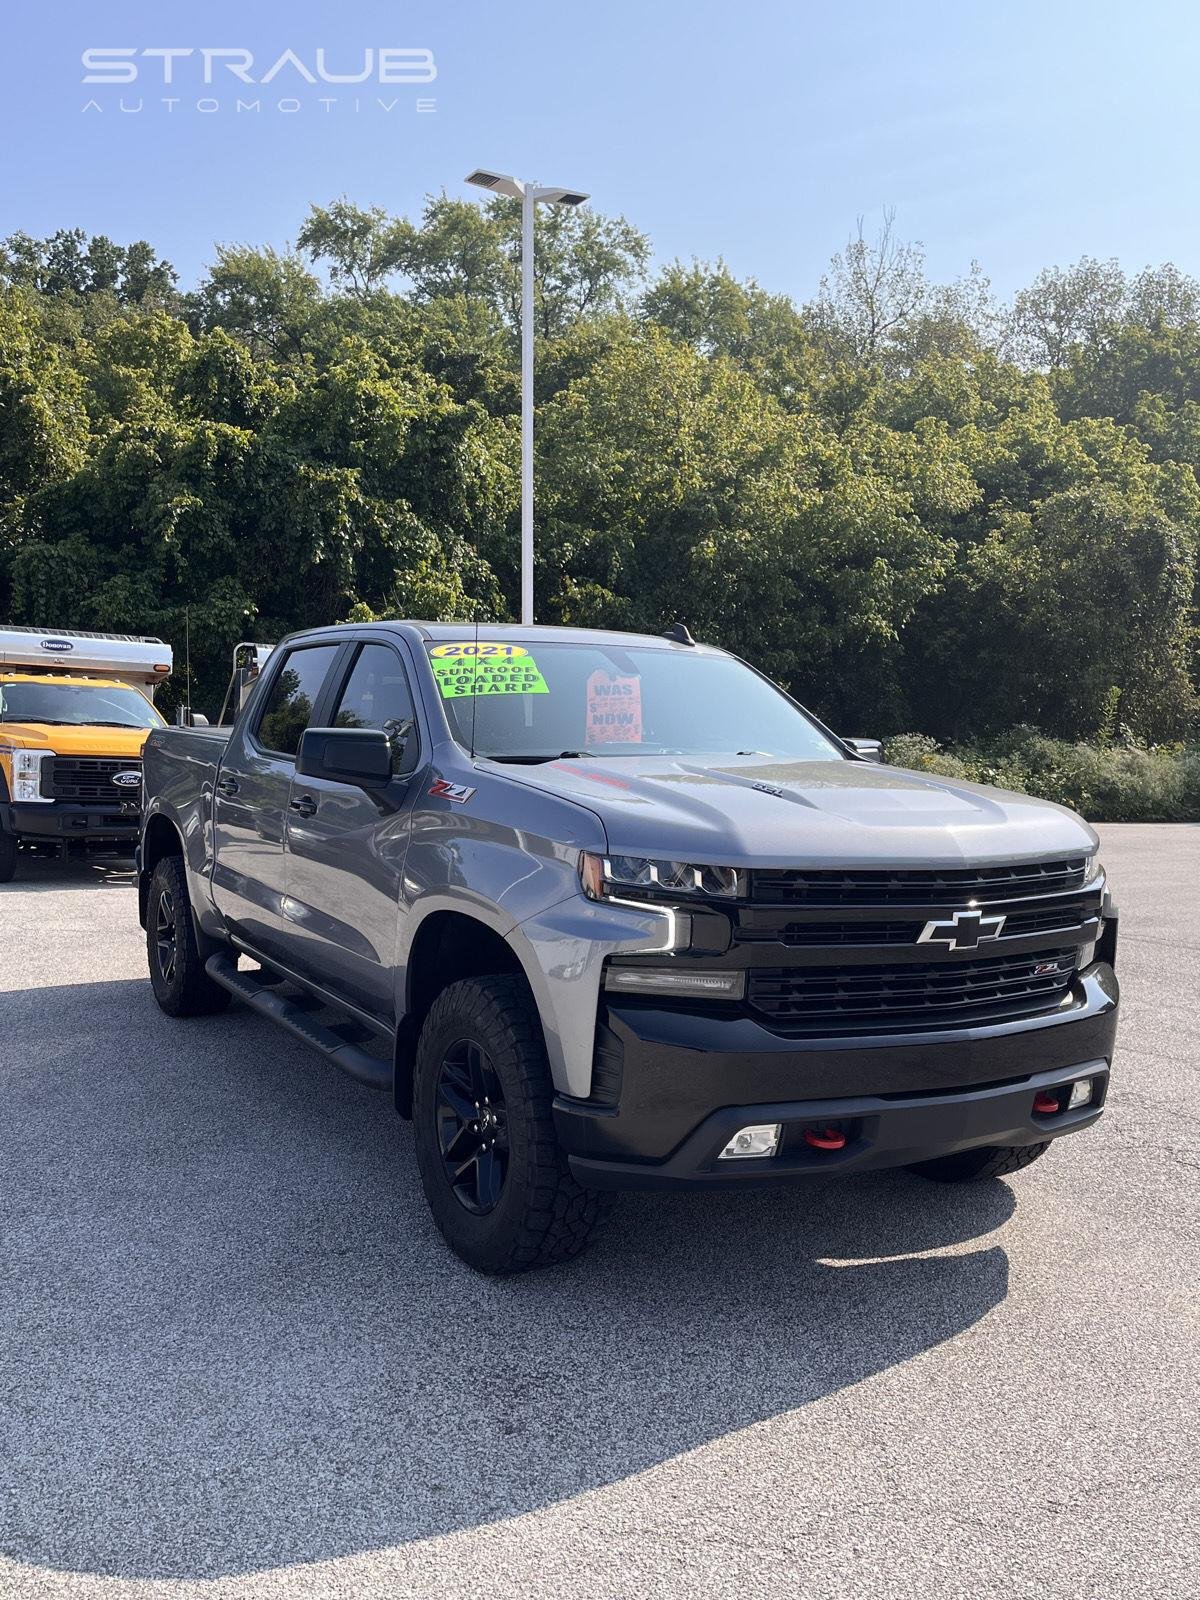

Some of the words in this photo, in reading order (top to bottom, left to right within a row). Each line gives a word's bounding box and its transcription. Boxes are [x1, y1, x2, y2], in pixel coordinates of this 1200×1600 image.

[42, 641, 72, 649] Donovan
[444, 646, 513, 656] 2021
[437, 668, 474, 676] SUN
[484, 666, 535, 674] ROOF
[444, 674, 538, 686] LOADED
[455, 684, 532, 694] SHARP
[594, 684, 633, 696] WAS
[592, 713, 634, 726] NOW
[121, 775, 140, 784] Ford
